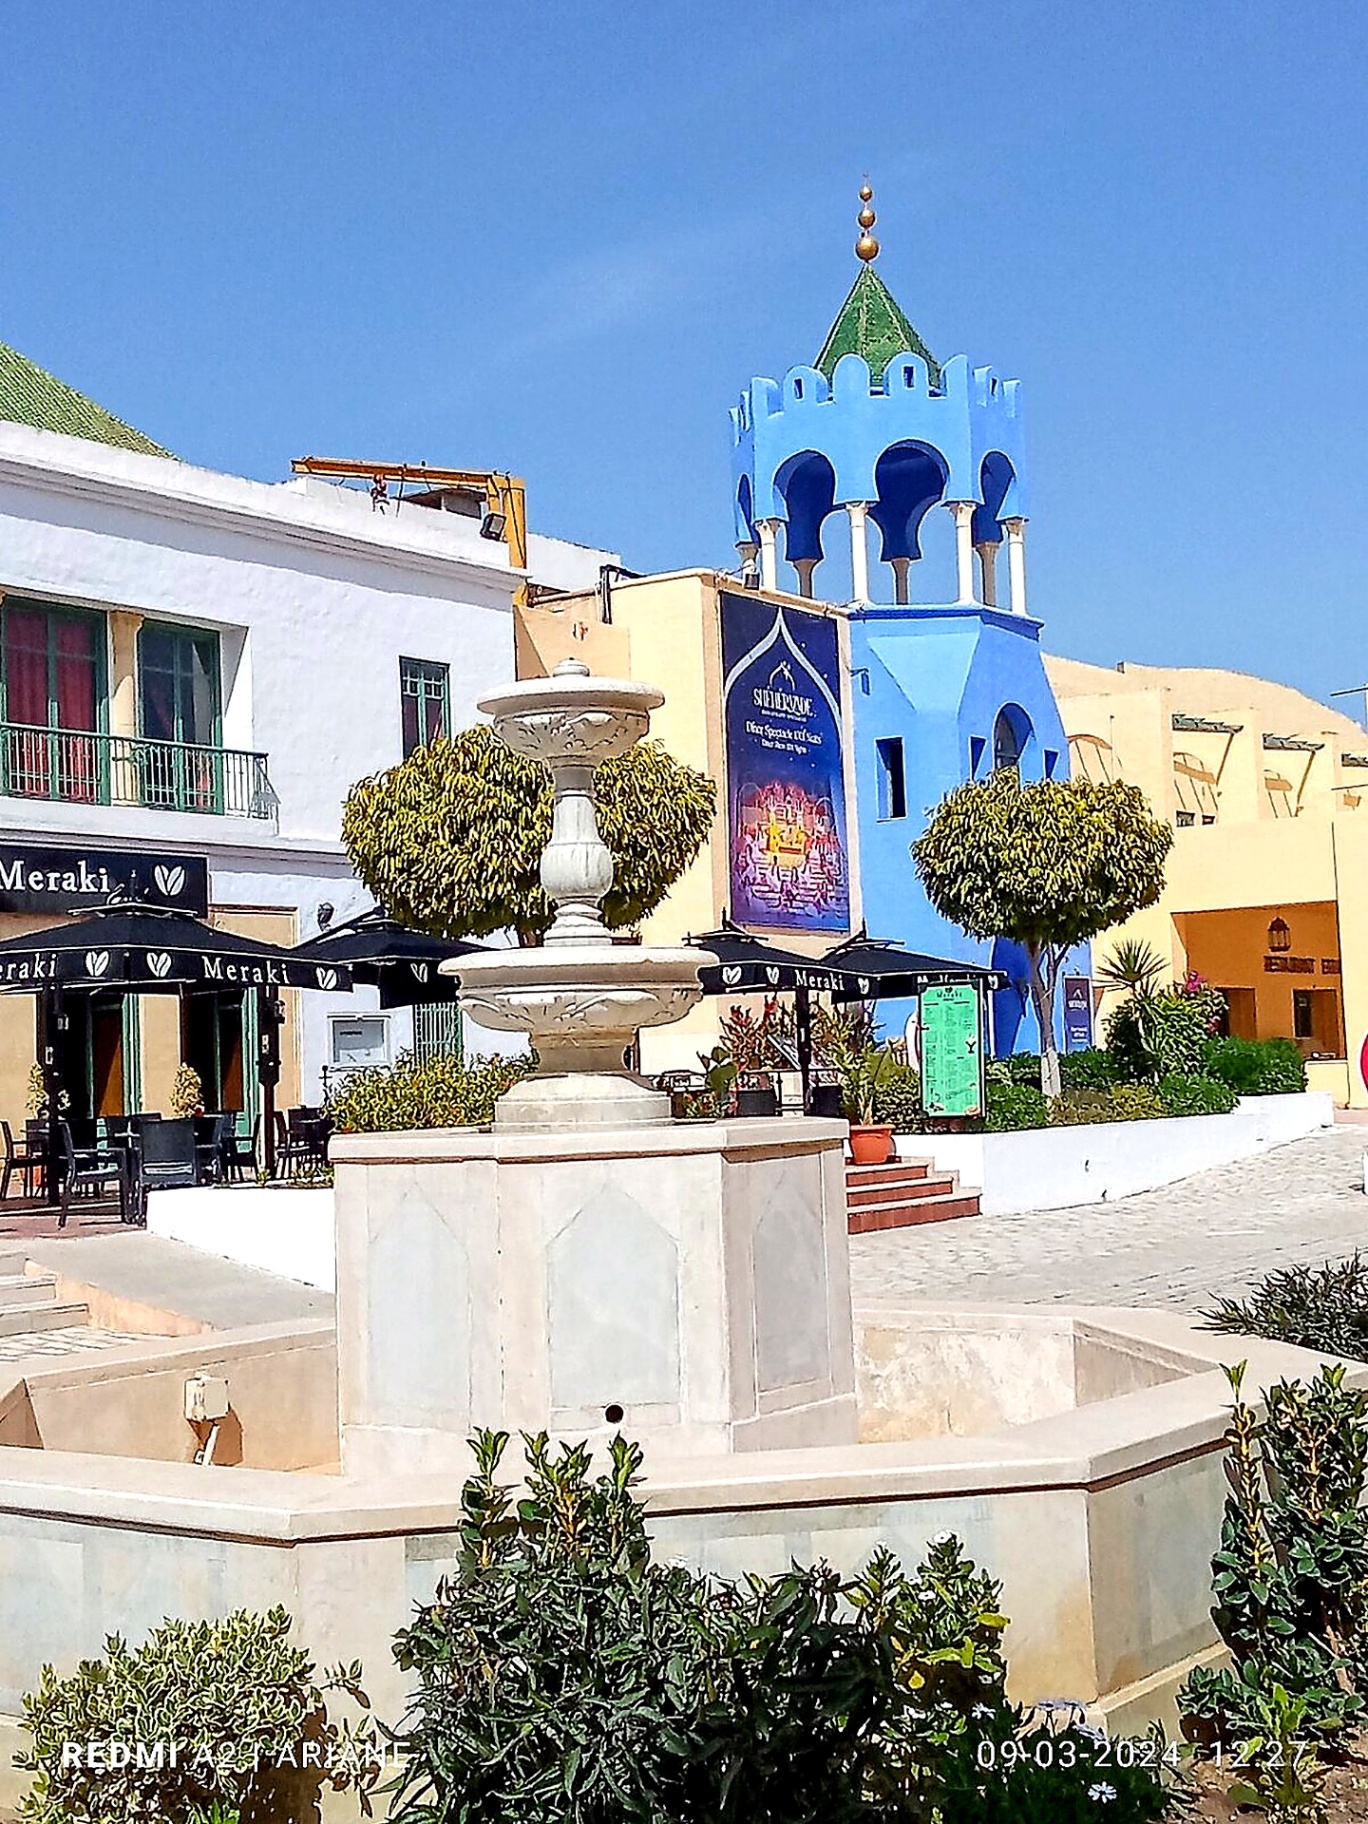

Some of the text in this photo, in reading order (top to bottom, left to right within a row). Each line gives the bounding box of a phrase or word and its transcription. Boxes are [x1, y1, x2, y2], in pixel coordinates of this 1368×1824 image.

[0, 860, 110, 893] Meraki
[201, 956, 290, 984] Meraki
[794, 969, 845, 991] Meraki
